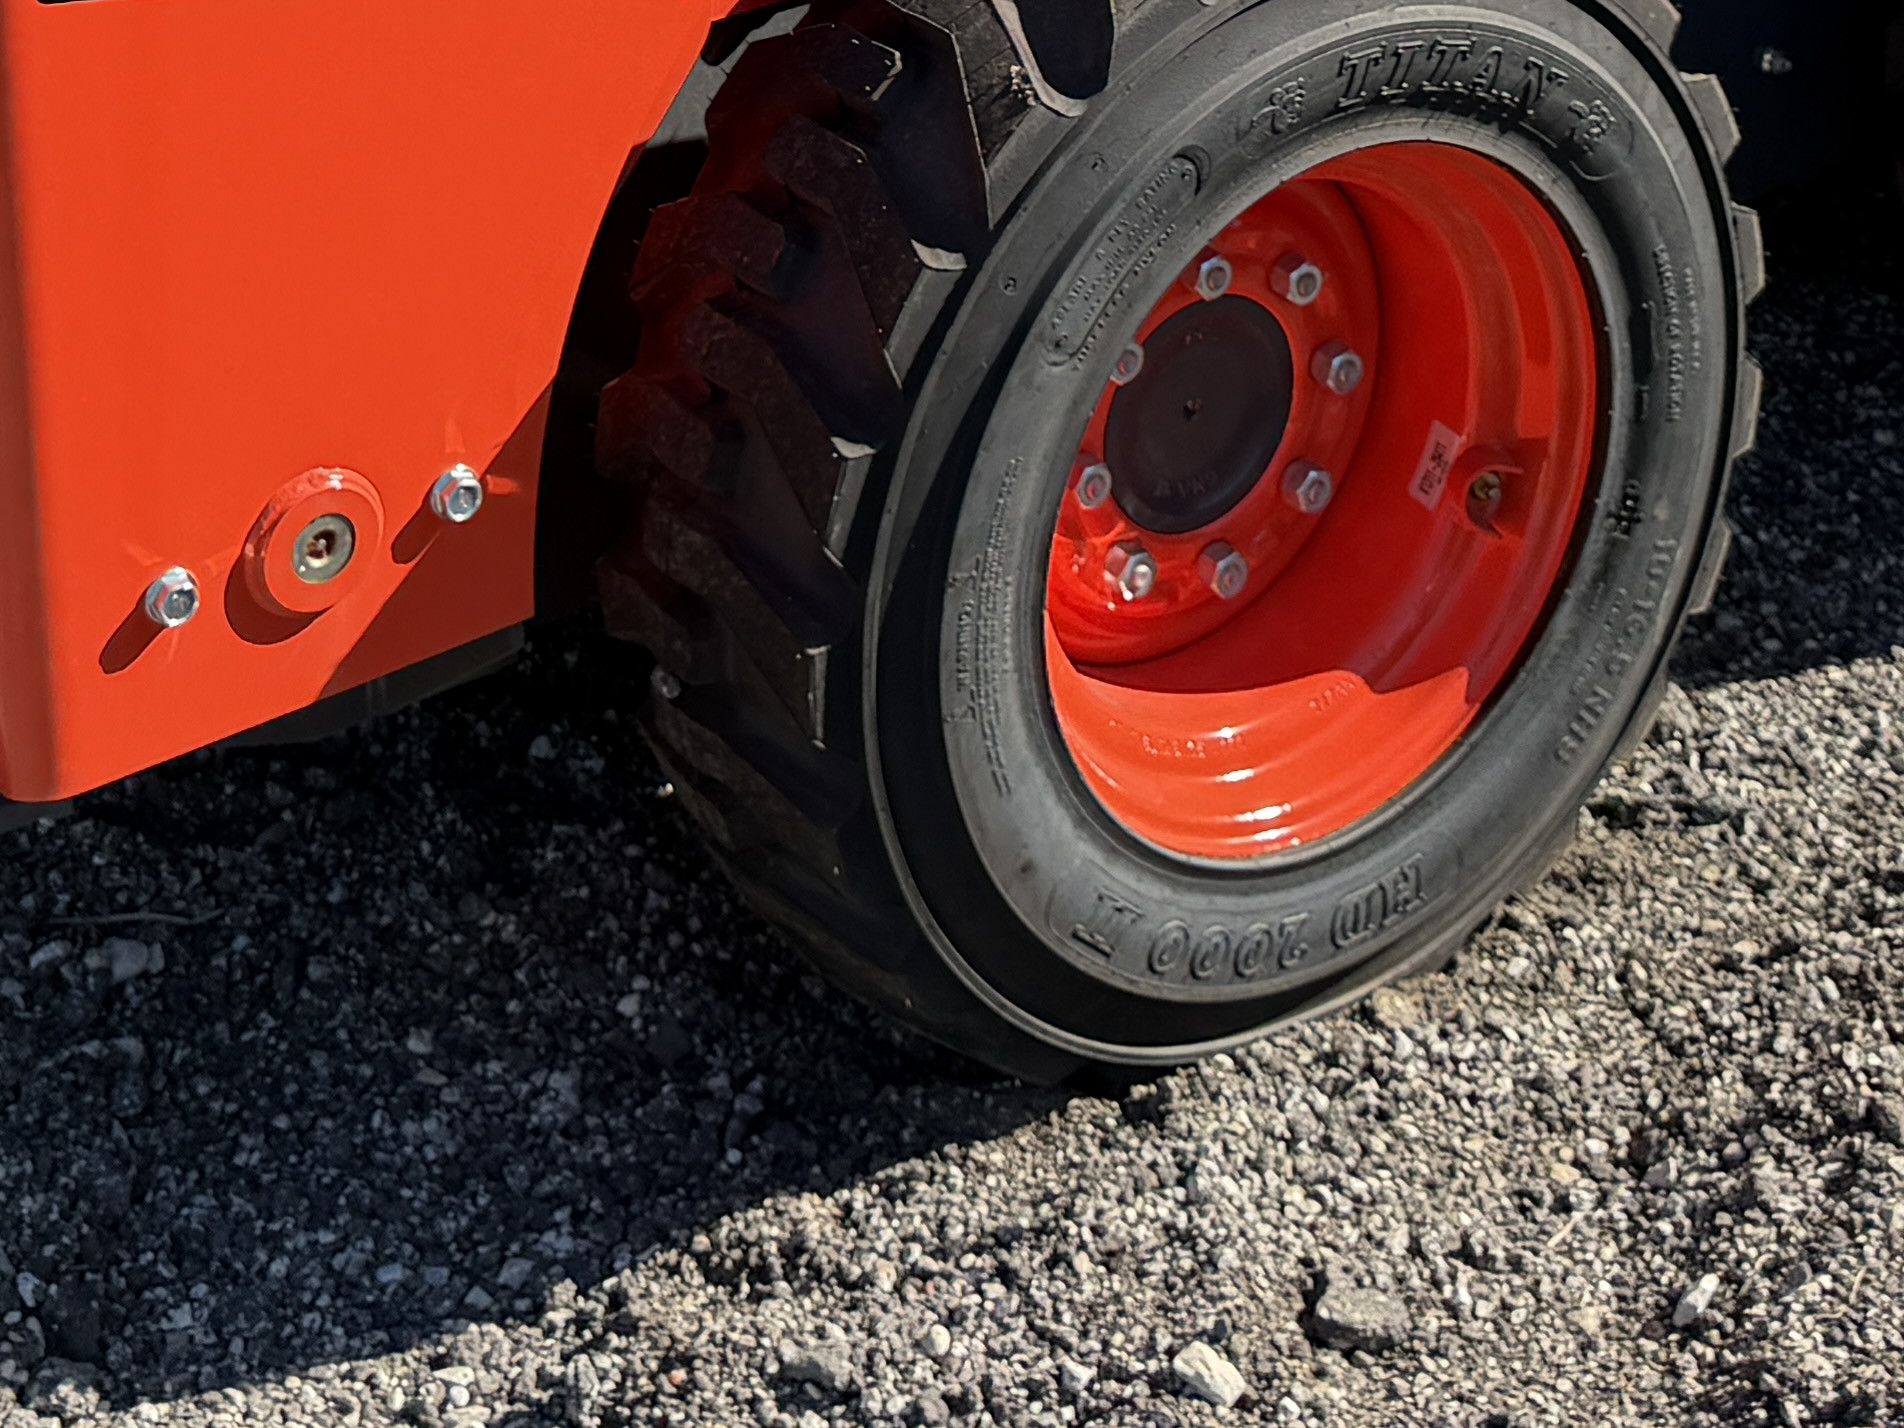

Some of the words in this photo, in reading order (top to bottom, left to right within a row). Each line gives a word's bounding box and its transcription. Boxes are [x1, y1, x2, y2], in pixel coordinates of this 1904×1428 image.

[1335, 34, 1571, 119] TITAN
[1330, 852, 1429, 950] HD
[1146, 912, 1314, 980] 2000
